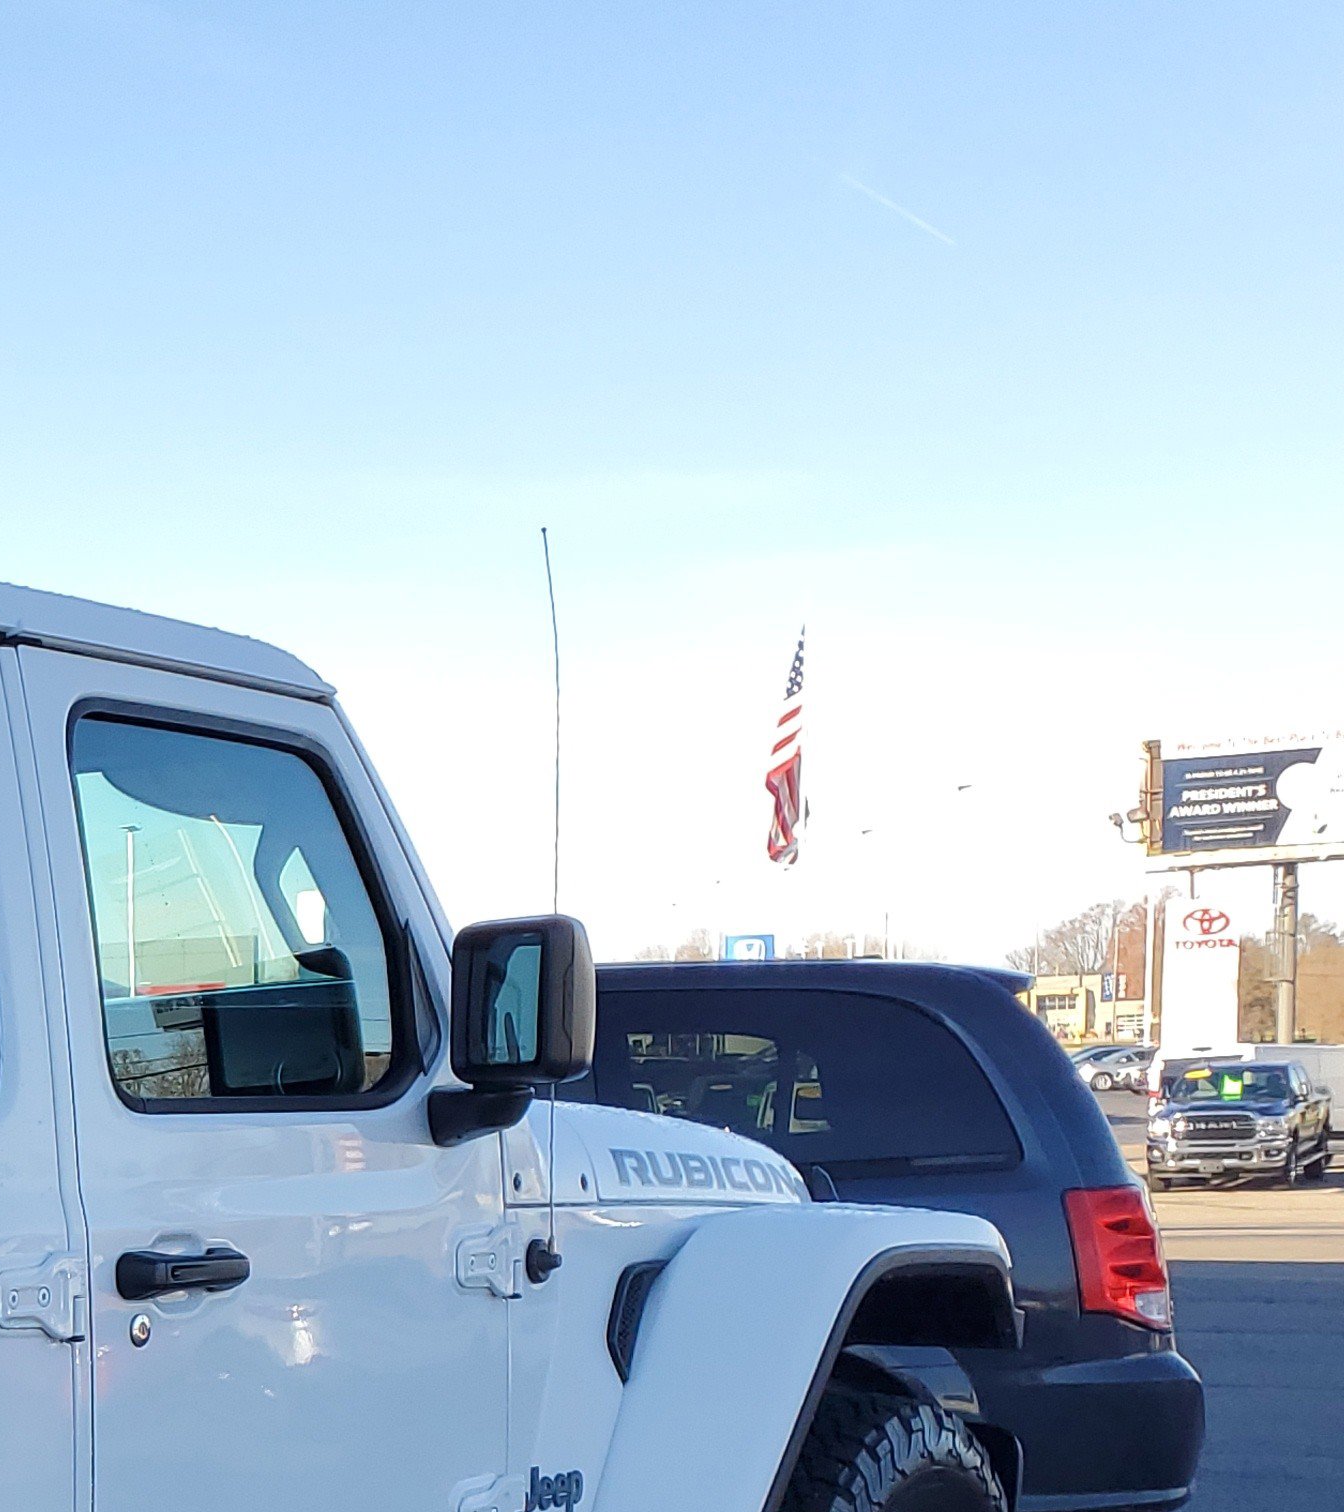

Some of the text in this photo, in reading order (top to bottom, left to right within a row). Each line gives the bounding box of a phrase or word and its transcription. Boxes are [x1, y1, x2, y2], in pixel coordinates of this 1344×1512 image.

[1169, 798, 1279, 818] AWARD WINNER
[1175, 939, 1238, 950] TOYOTA
[609, 1147, 796, 1197] RUBICON
